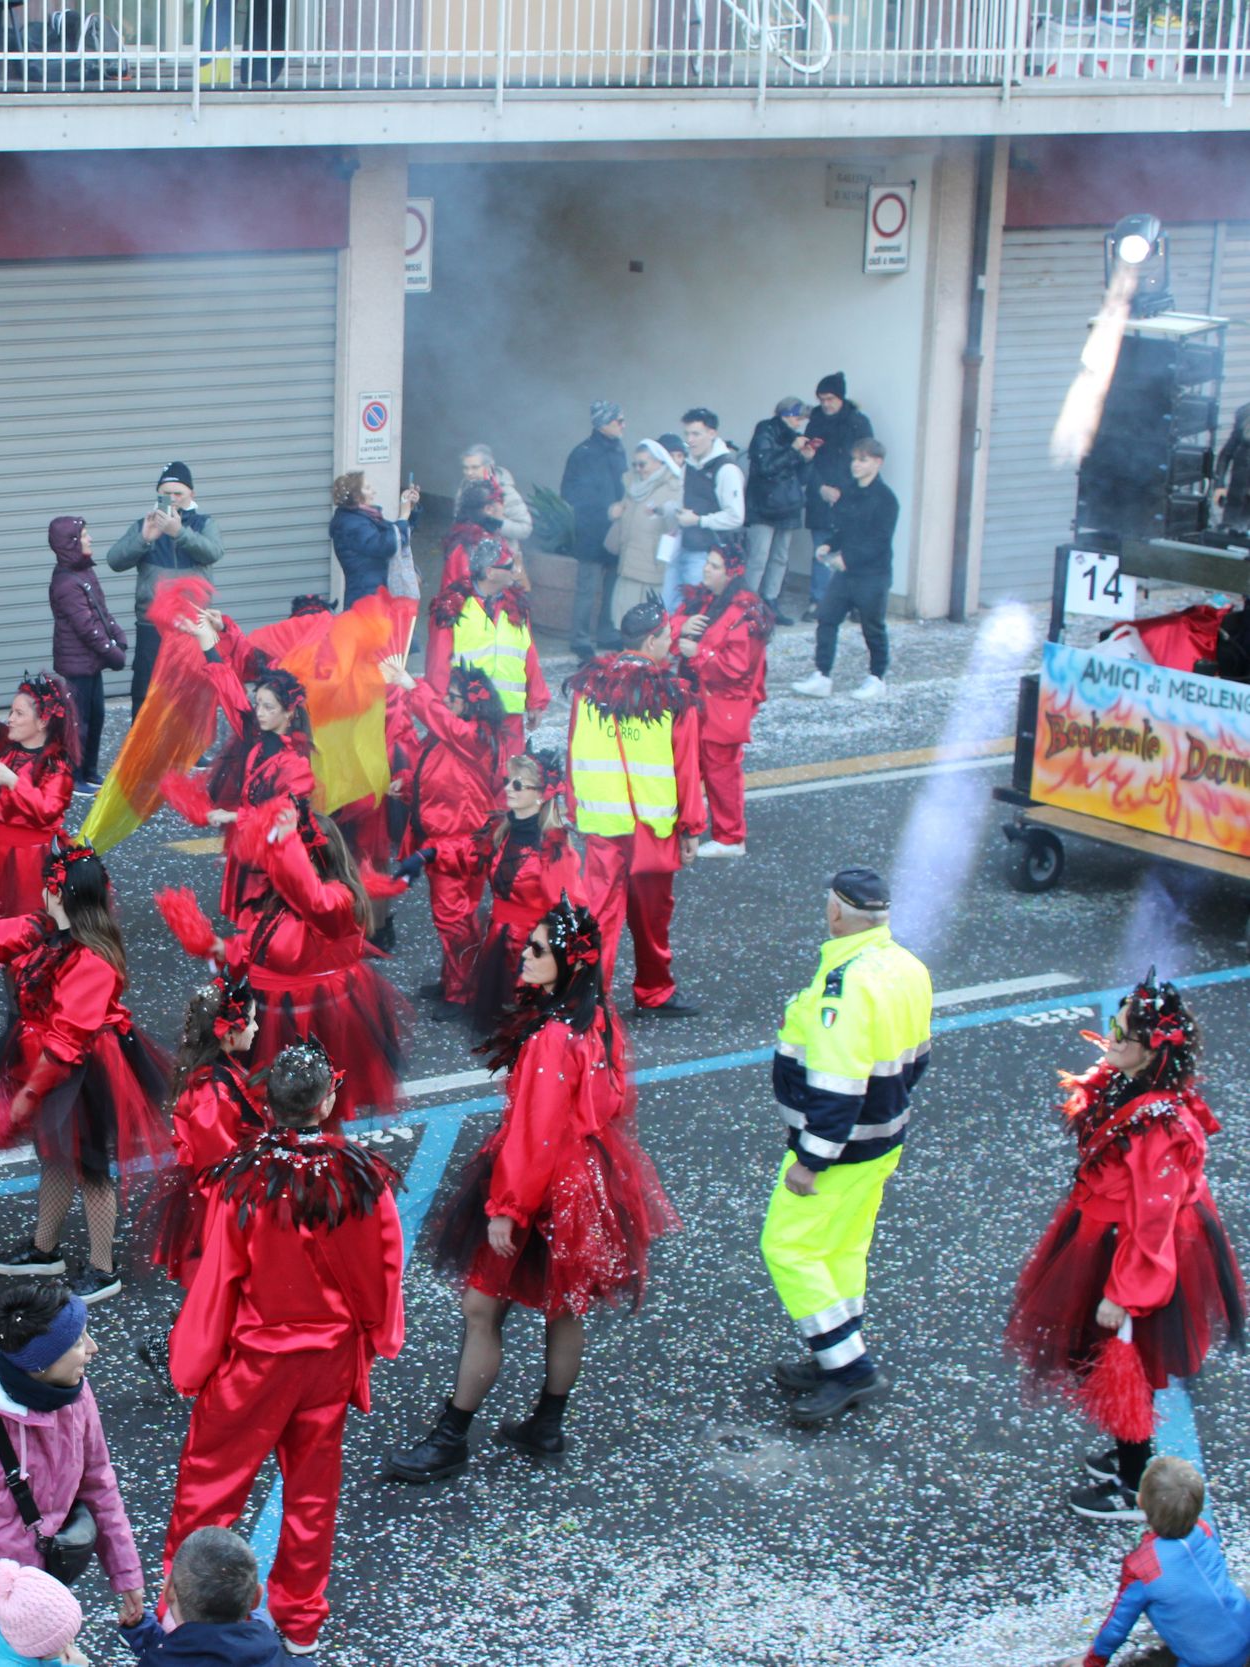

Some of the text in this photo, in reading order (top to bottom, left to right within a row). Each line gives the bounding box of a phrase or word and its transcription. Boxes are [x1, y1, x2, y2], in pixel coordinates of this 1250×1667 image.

[1083, 565, 1123, 604] 14
[1081, 657, 1140, 691] AMICI
[1147, 674, 1161, 694] di
[606, 724, 641, 742] CRRO
